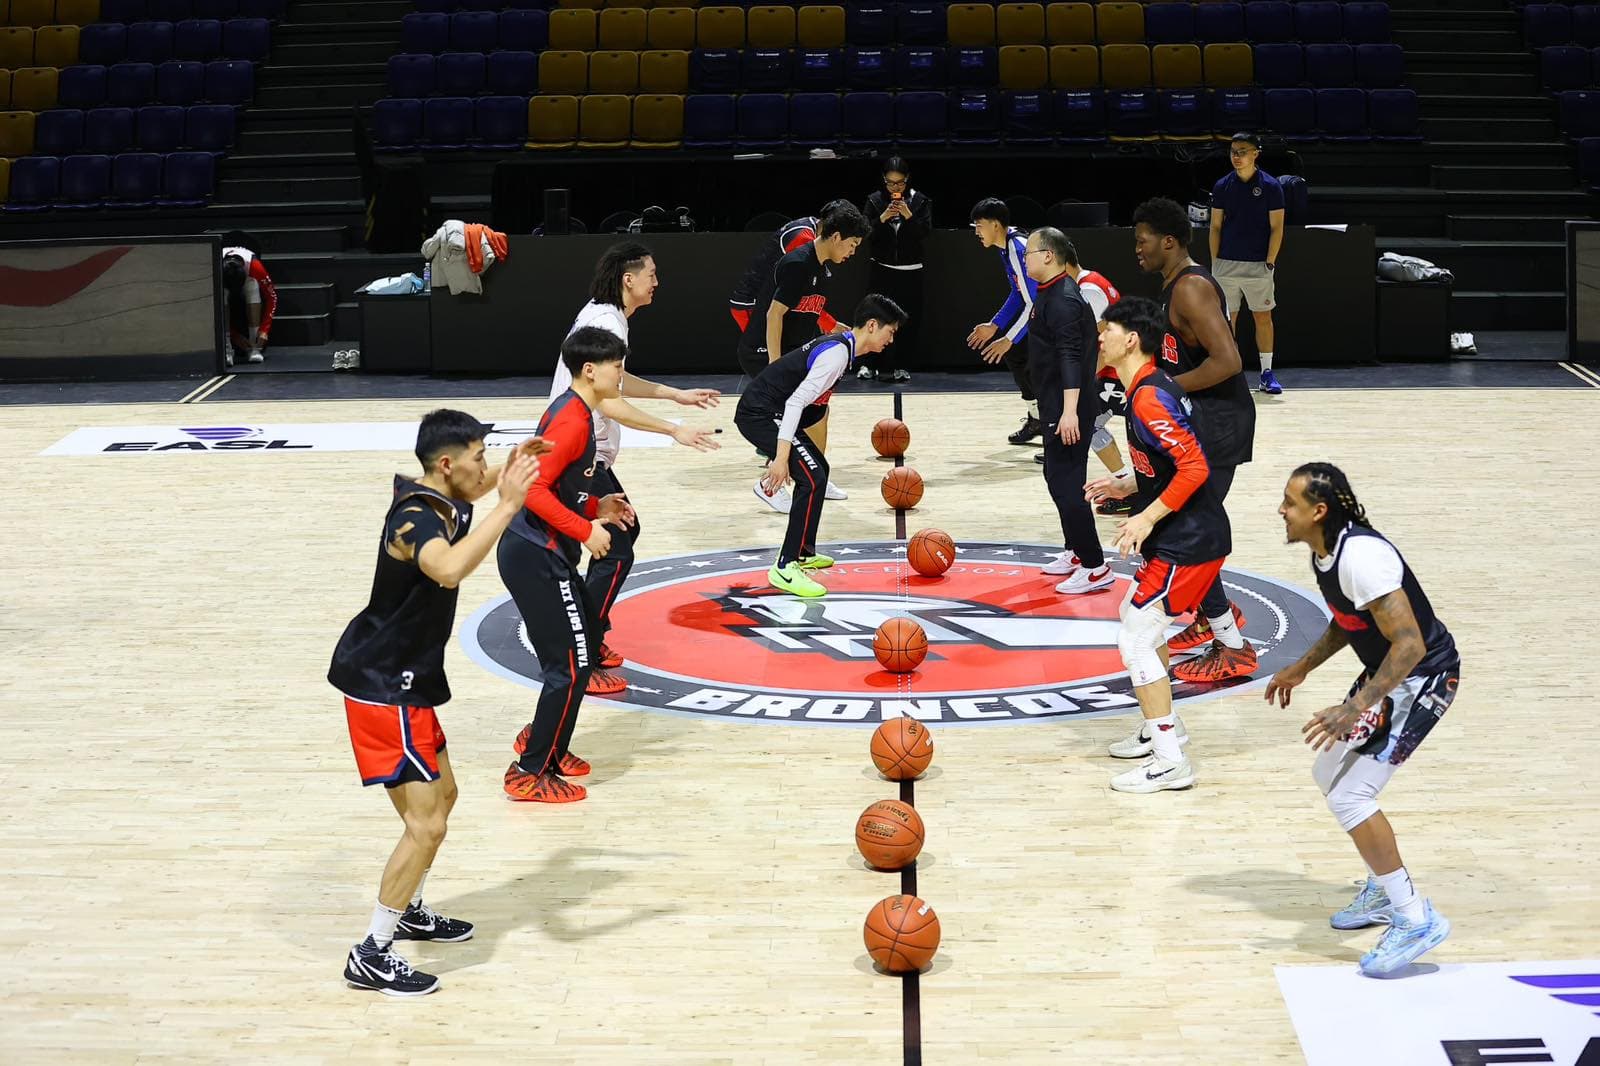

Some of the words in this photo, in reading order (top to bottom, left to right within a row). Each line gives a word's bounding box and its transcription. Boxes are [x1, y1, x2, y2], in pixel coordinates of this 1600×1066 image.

[102, 440, 313, 452] EASL
[950, 566, 1021, 576] 004
[575, 633, 589, 668] ТАВАН
[401, 671, 414, 690] 3
[665, 685, 1140, 721] BRONCOS
